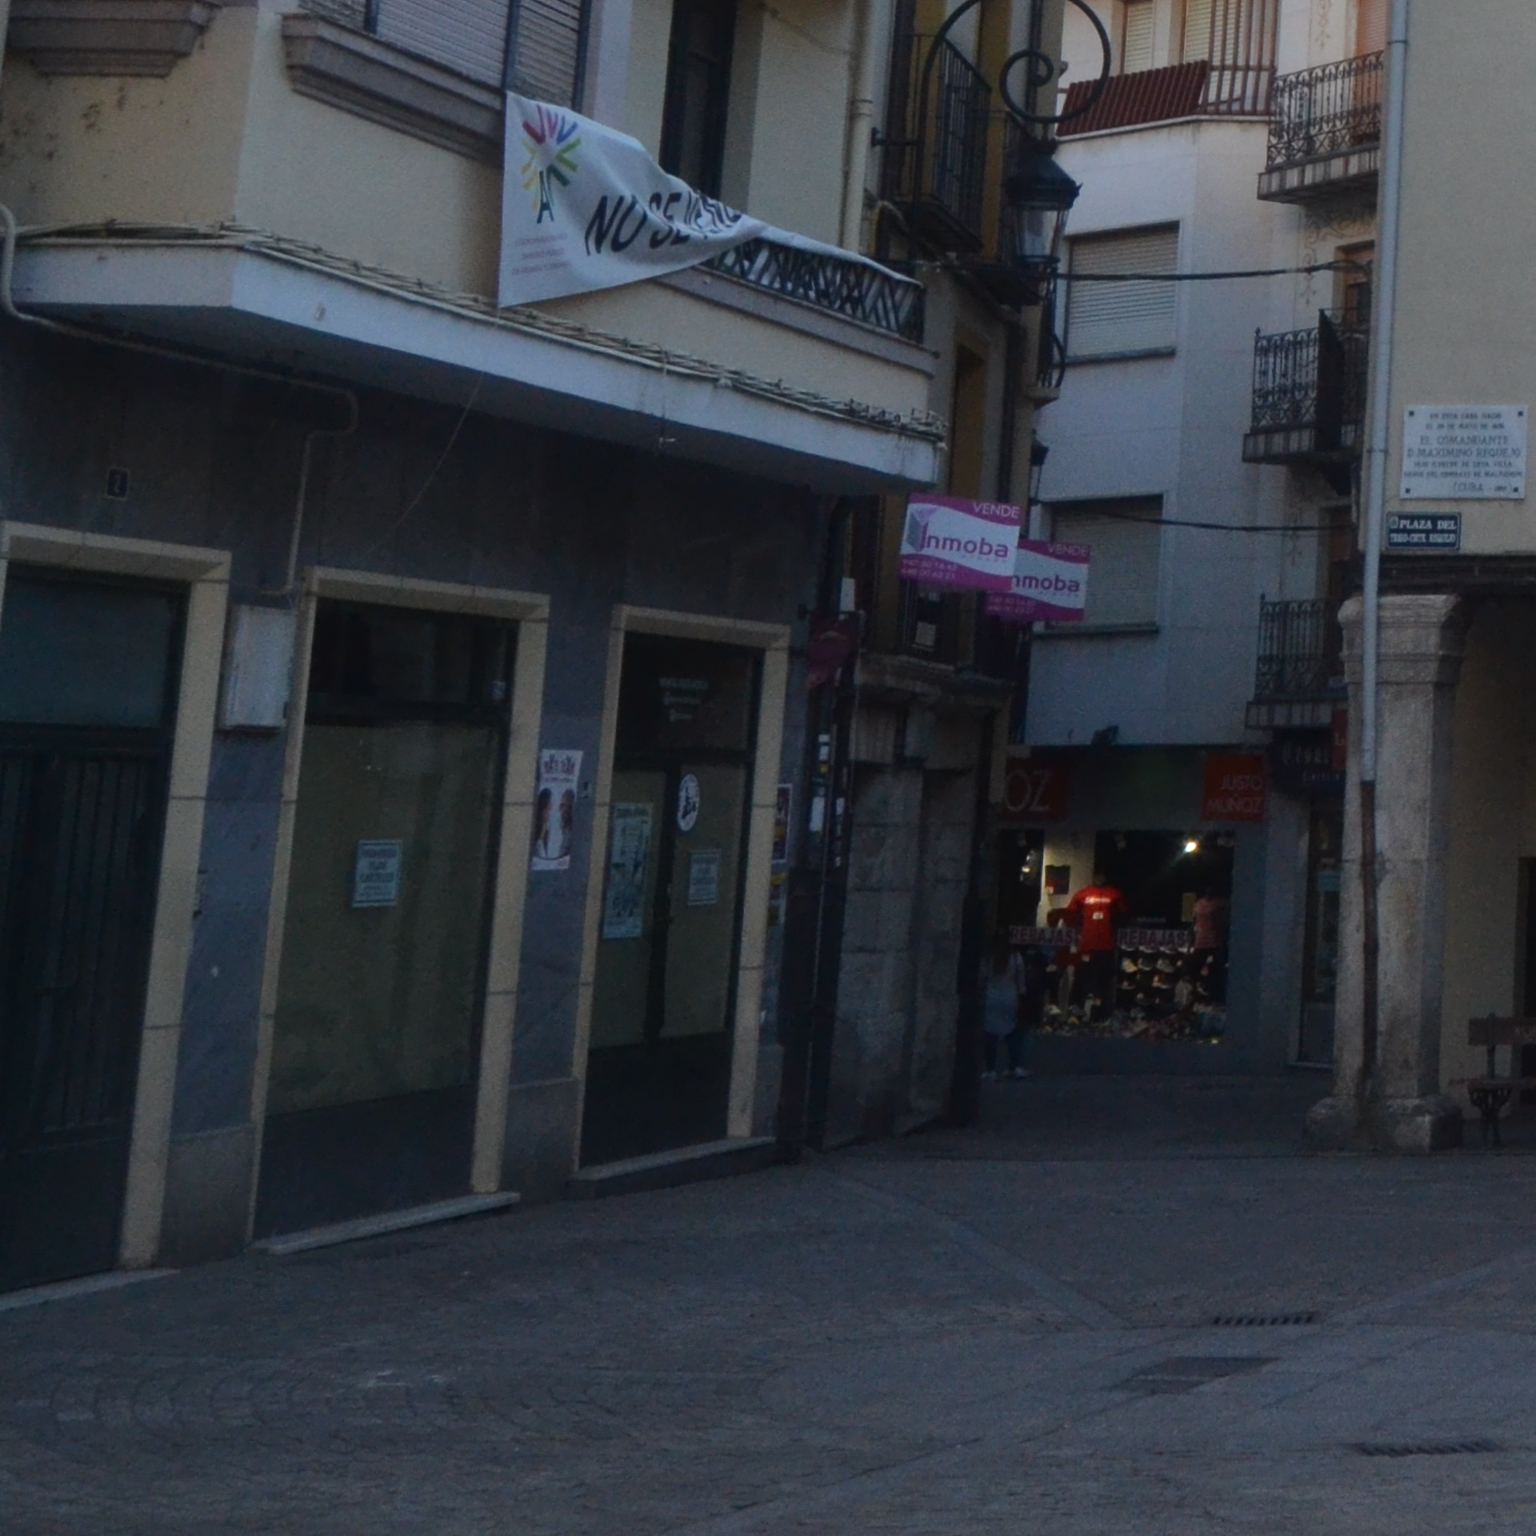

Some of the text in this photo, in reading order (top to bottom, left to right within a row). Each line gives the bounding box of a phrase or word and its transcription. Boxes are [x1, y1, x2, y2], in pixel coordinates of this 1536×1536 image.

[585, 195, 648, 256] NO
[648, 192, 691, 249] SE
[1420, 436, 1509, 446] EL COMANDANTE
[973, 502, 1020, 519] VENDE
[1400, 519, 1457, 530] PLAZA DEL
[1046, 543, 1088, 557] VENDE
[1012, 574, 1081, 593] nmoba
[1220, 774, 1263, 791] JUSTO
[1206, 792, 1263, 814] MUÑOZ
[1011, 928, 1076, 944] REBAJAS
[1119, 929, 1186, 946] REBAJAS
